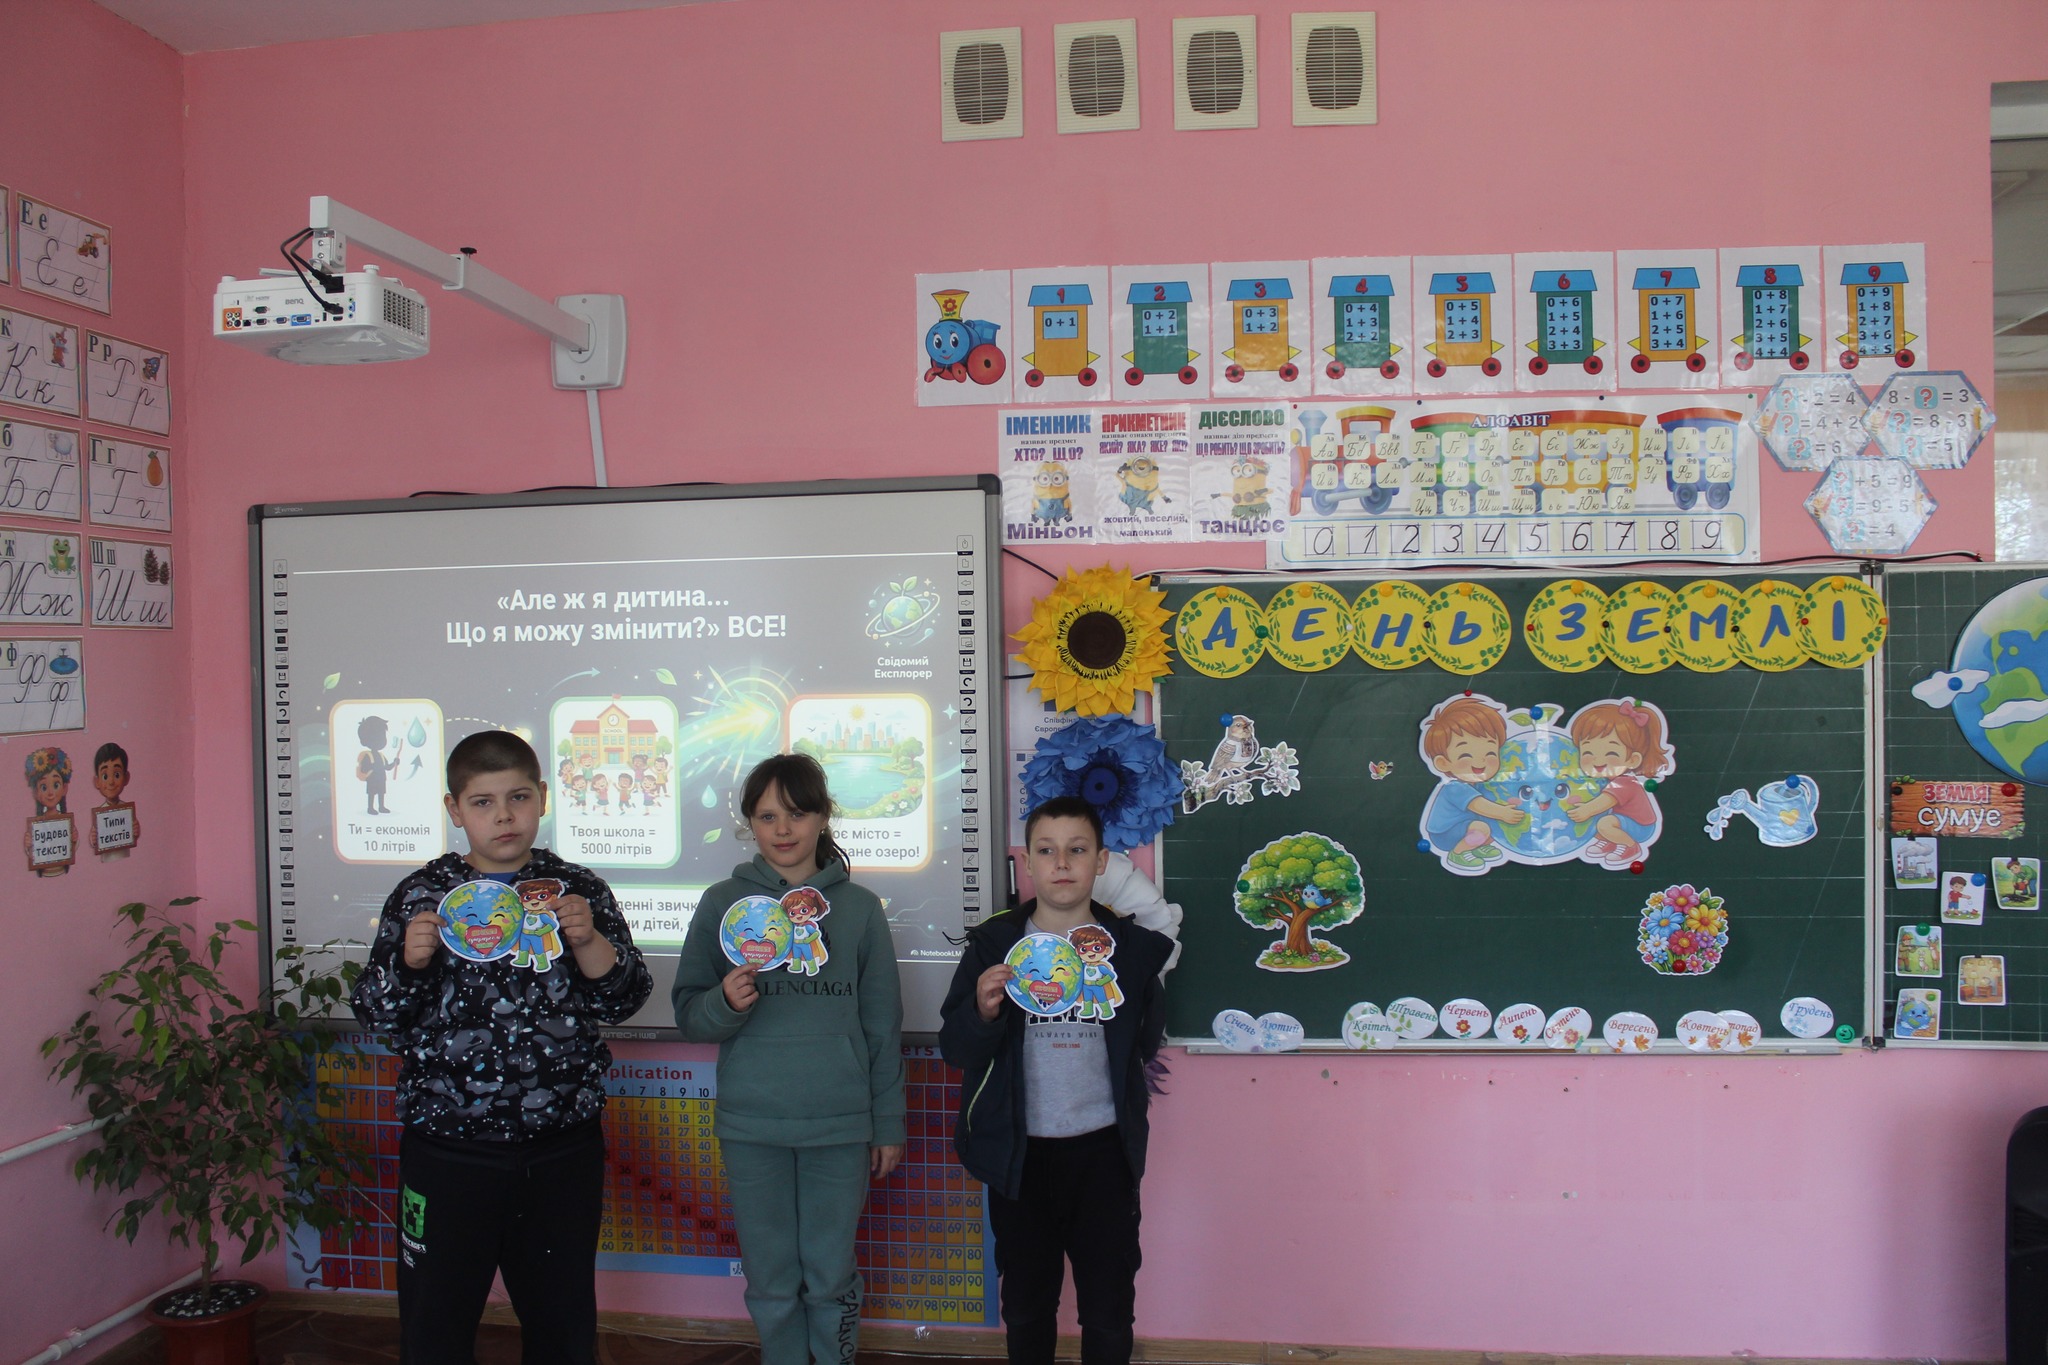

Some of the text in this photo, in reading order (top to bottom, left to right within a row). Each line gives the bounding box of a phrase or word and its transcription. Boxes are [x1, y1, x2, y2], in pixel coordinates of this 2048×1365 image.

[1660, 270, 1673, 287] 7
[1764, 268, 1777, 284] 8
[1868, 265, 1881, 282] 9
[1355, 278, 1369, 294] 4
[1456, 275, 1469, 292] 5
[1558, 273, 1571, 290] 6
[1057, 288, 1065, 303] 1
[1153, 285, 1167, 301] 2
[1254, 282, 1267, 298] 3
[1006, 415, 1091, 435] ІМЕННИК
[1102, 412, 1186, 432] ПРИКМЕТНИК
[1199, 409, 1285, 430] ДІЄСЛОВО
[1471, 414, 1550, 428] АЛФАВІТ
[1014, 446, 1084, 462] ХТО? ЩО?
[1104, 515, 1142, 524] жовтий,
[1007, 523, 1093, 540] Міньон
[1200, 519, 1285, 536] танцює
[1313, 521, 1721, 554] 0 1 2 3 4 5 6 7 8 9
[497, 589, 729, 613] «Але ж я дитина...
[447, 615, 786, 648] Що я можу змінити?» ВСЕ!
[1201, 600, 1845, 650] ДЕНЬ ЗЕМЛІ
[877, 655, 929, 667] Свідомий
[874, 669, 932, 680] Експлорер
[1923, 784, 1990, 803] ЗЕМЛЯ
[104, 817, 125, 828] Типи
[348, 823, 362, 835] Ти
[376, 824, 430, 835] економія
[34, 829, 69, 843] Будова
[99, 829, 130, 844] текстів
[570, 825, 600, 837] Твоя
[604, 828, 645, 837] школа
[833, 830, 848, 840] оє
[852, 827, 889, 840] місто
[36, 845, 67, 856] тексту
[364, 840, 415, 854] 10 літрів
[581, 843, 652, 857] 5000 літрів
[840, 846, 920, 860] ване озеро!
[616, 898, 698, 911] денні звичк
[643, 917, 683, 932] дітей,
[920, 949, 962, 957] NotebookLM
[755, 980, 852, 996] ALENCIAGA
[1389, 1003, 1438, 1022] Травень
[1444, 1004, 1489, 1018] Червень
[1789, 1003, 1832, 1018] Грудень
[1224, 1013, 1256, 1035] Січень
[1260, 1019, 1300, 1033] Лютий
[1499, 1008, 1538, 1029] Липень
[1353, 1021, 1391, 1032] Квітен
[1608, 1020, 1656, 1034] Вересень
[1678, 1019, 1730, 1035] Жовтень
[1728, 1021, 1760, 1033] топад
[901, 1045, 934, 1056] ers
[680, 1087, 709, 1097] 9 10
[967, 1248, 982, 1260] 80
[967, 1274, 982, 1287] 90
[941, 1301, 983, 1313] 99 100
